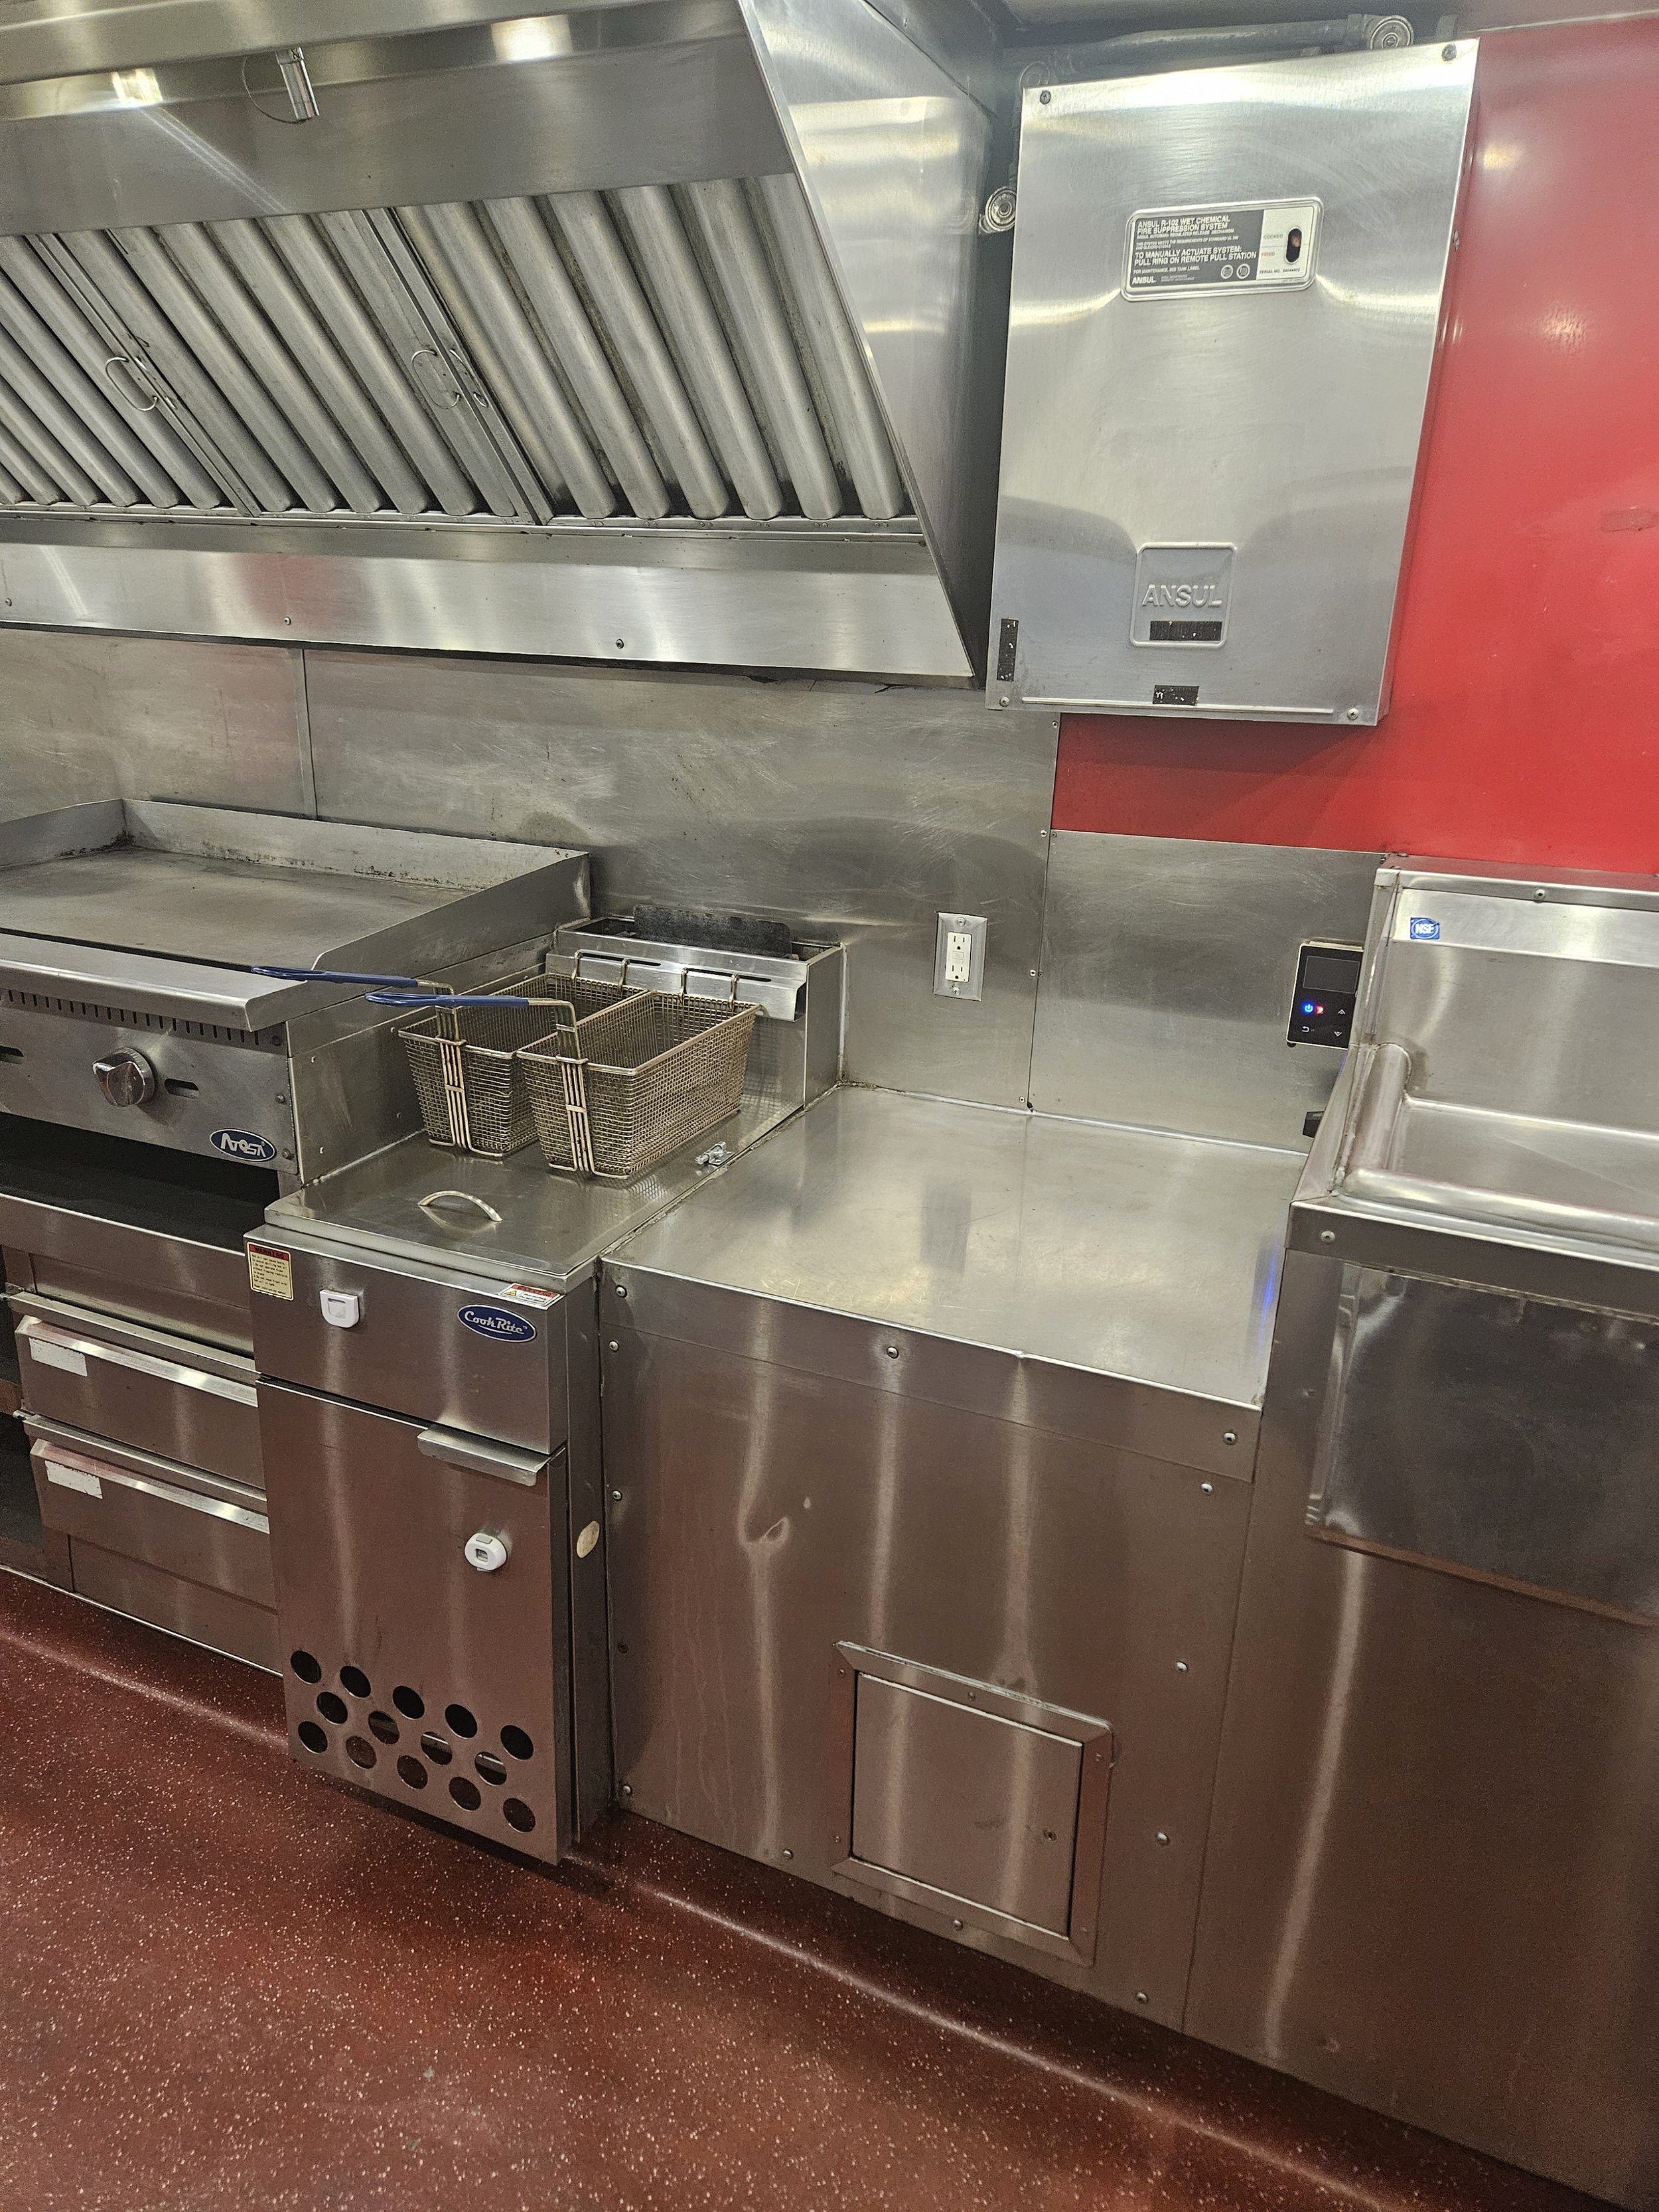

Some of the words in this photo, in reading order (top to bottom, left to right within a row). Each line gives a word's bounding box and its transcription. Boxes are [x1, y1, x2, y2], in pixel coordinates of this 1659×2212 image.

[1196, 215, 1230, 224] CHEMICAL
[1153, 224, 1199, 234] SUPPRESSION
[1145, 250, 1181, 258] MANUALLY
[1181, 248, 1212, 256] ACTUATE
[1181, 255, 1209, 263] REMOTE
[1228, 252, 1257, 260] STATION
[1141, 584, 1222, 607] ANSUL
[1415, 923, 1434, 934] NSF
[254, 1246, 284, 1260] WARNING
